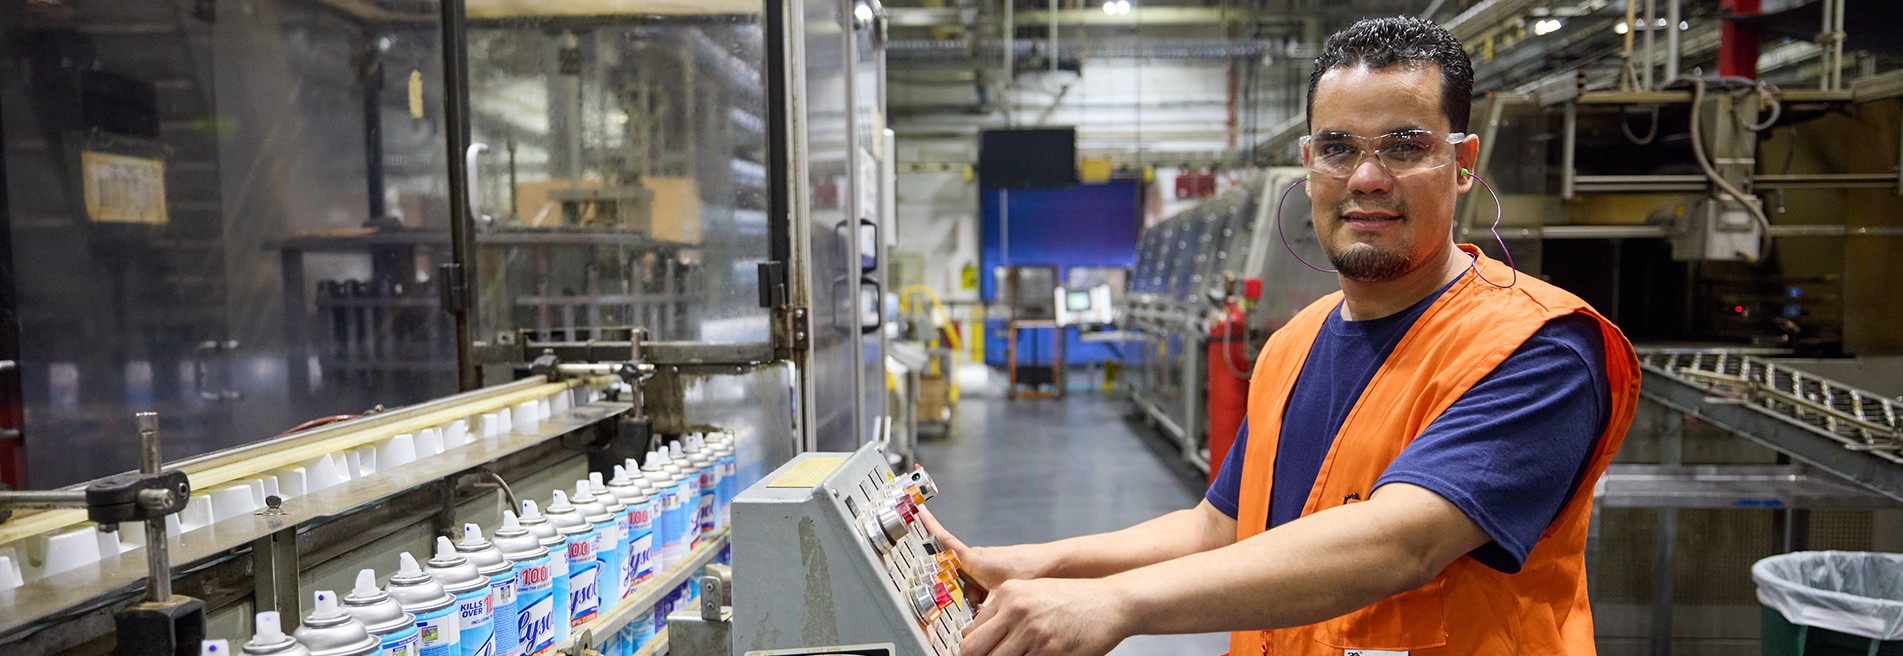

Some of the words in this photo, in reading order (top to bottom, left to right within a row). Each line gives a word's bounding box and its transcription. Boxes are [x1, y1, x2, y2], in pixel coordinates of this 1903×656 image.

[628, 510, 648, 525] 100
[521, 565, 548, 586] 100
[460, 599, 483, 612] KILLS
[462, 607, 483, 618] OVER
